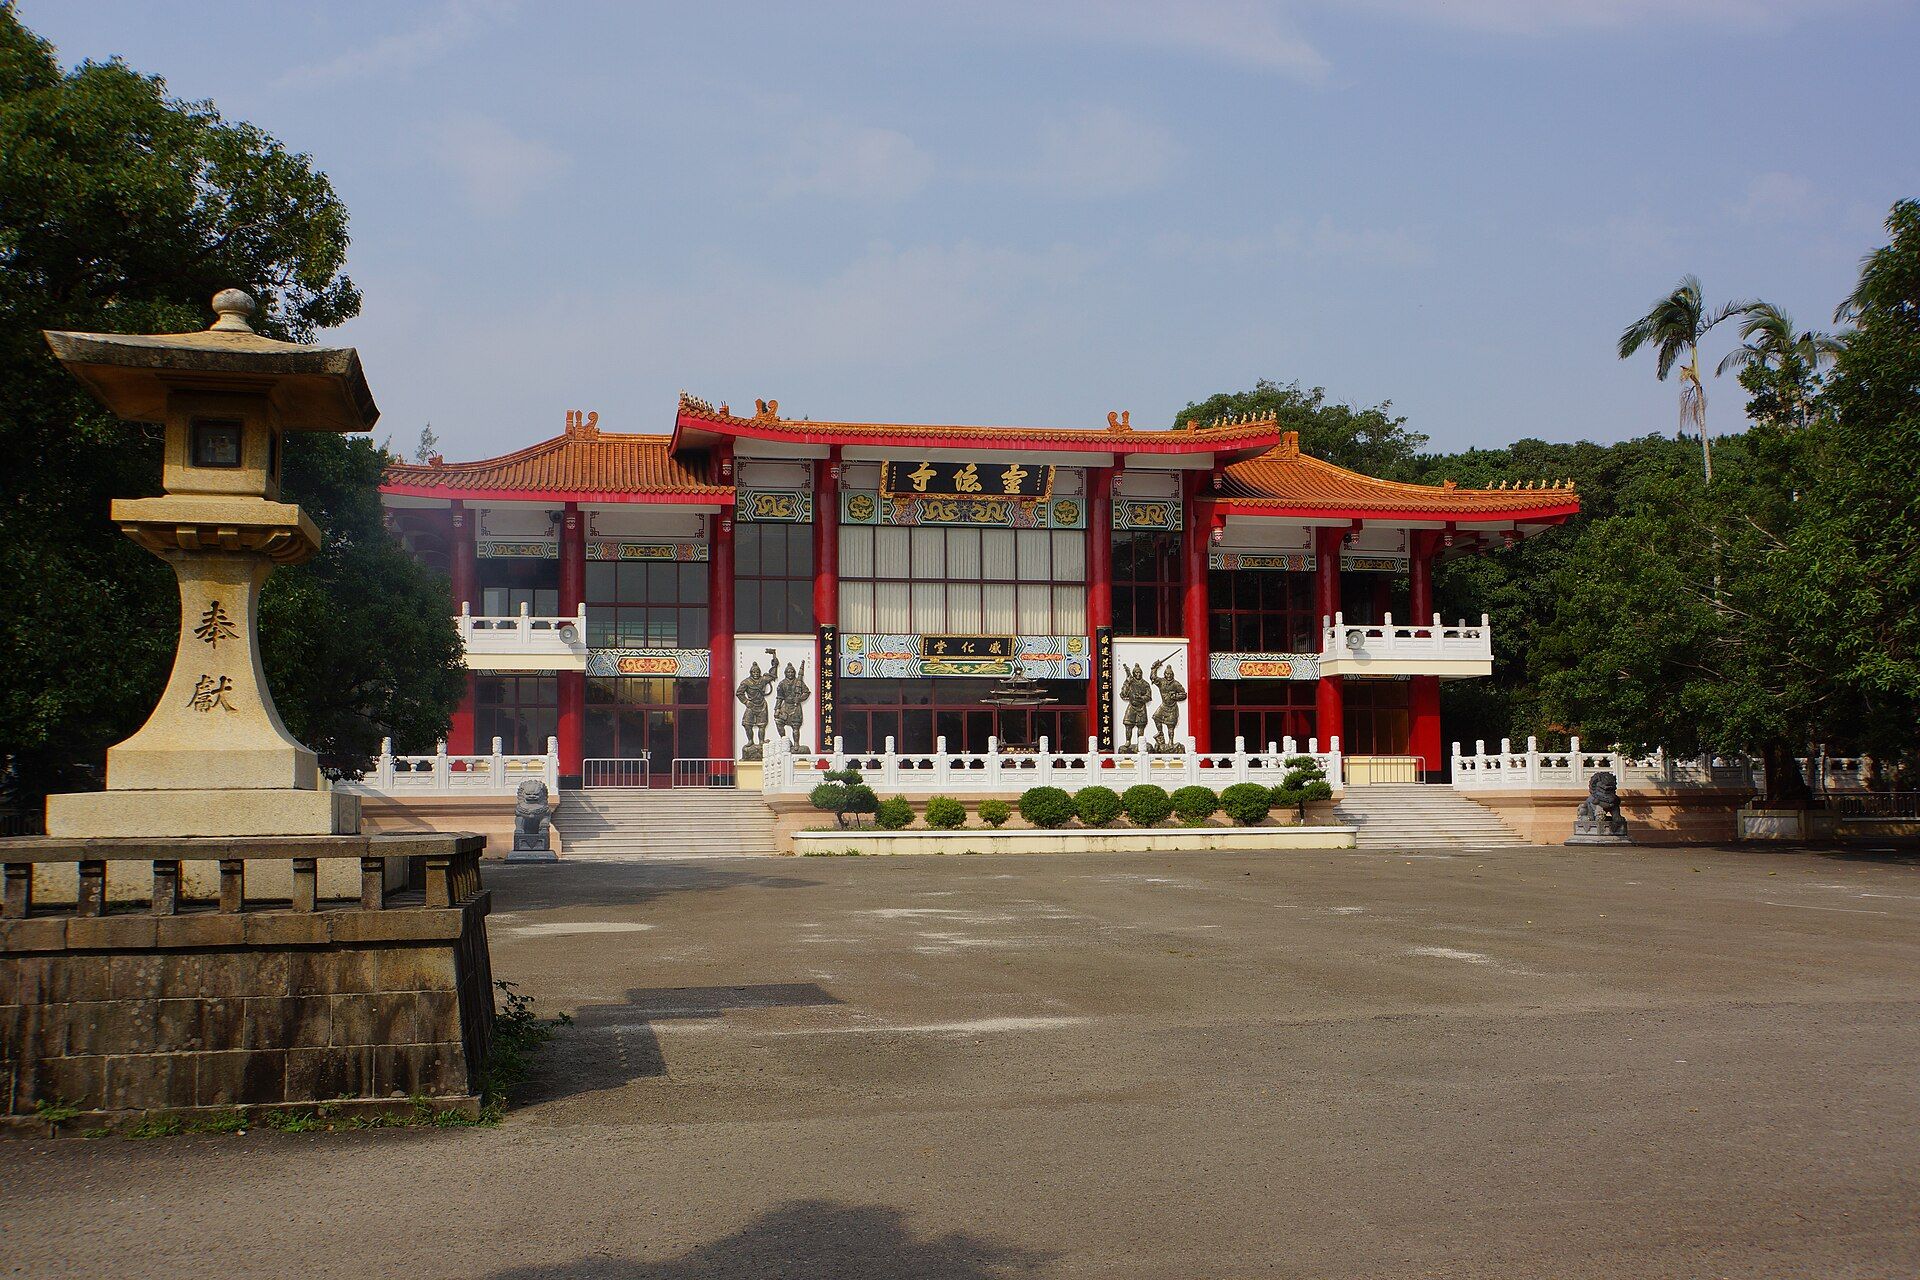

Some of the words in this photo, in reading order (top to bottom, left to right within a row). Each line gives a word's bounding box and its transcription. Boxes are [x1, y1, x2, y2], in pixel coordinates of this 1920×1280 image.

[186, 600, 240, 712] 奉獻
[933, 640, 1002, 655] 感化堂
